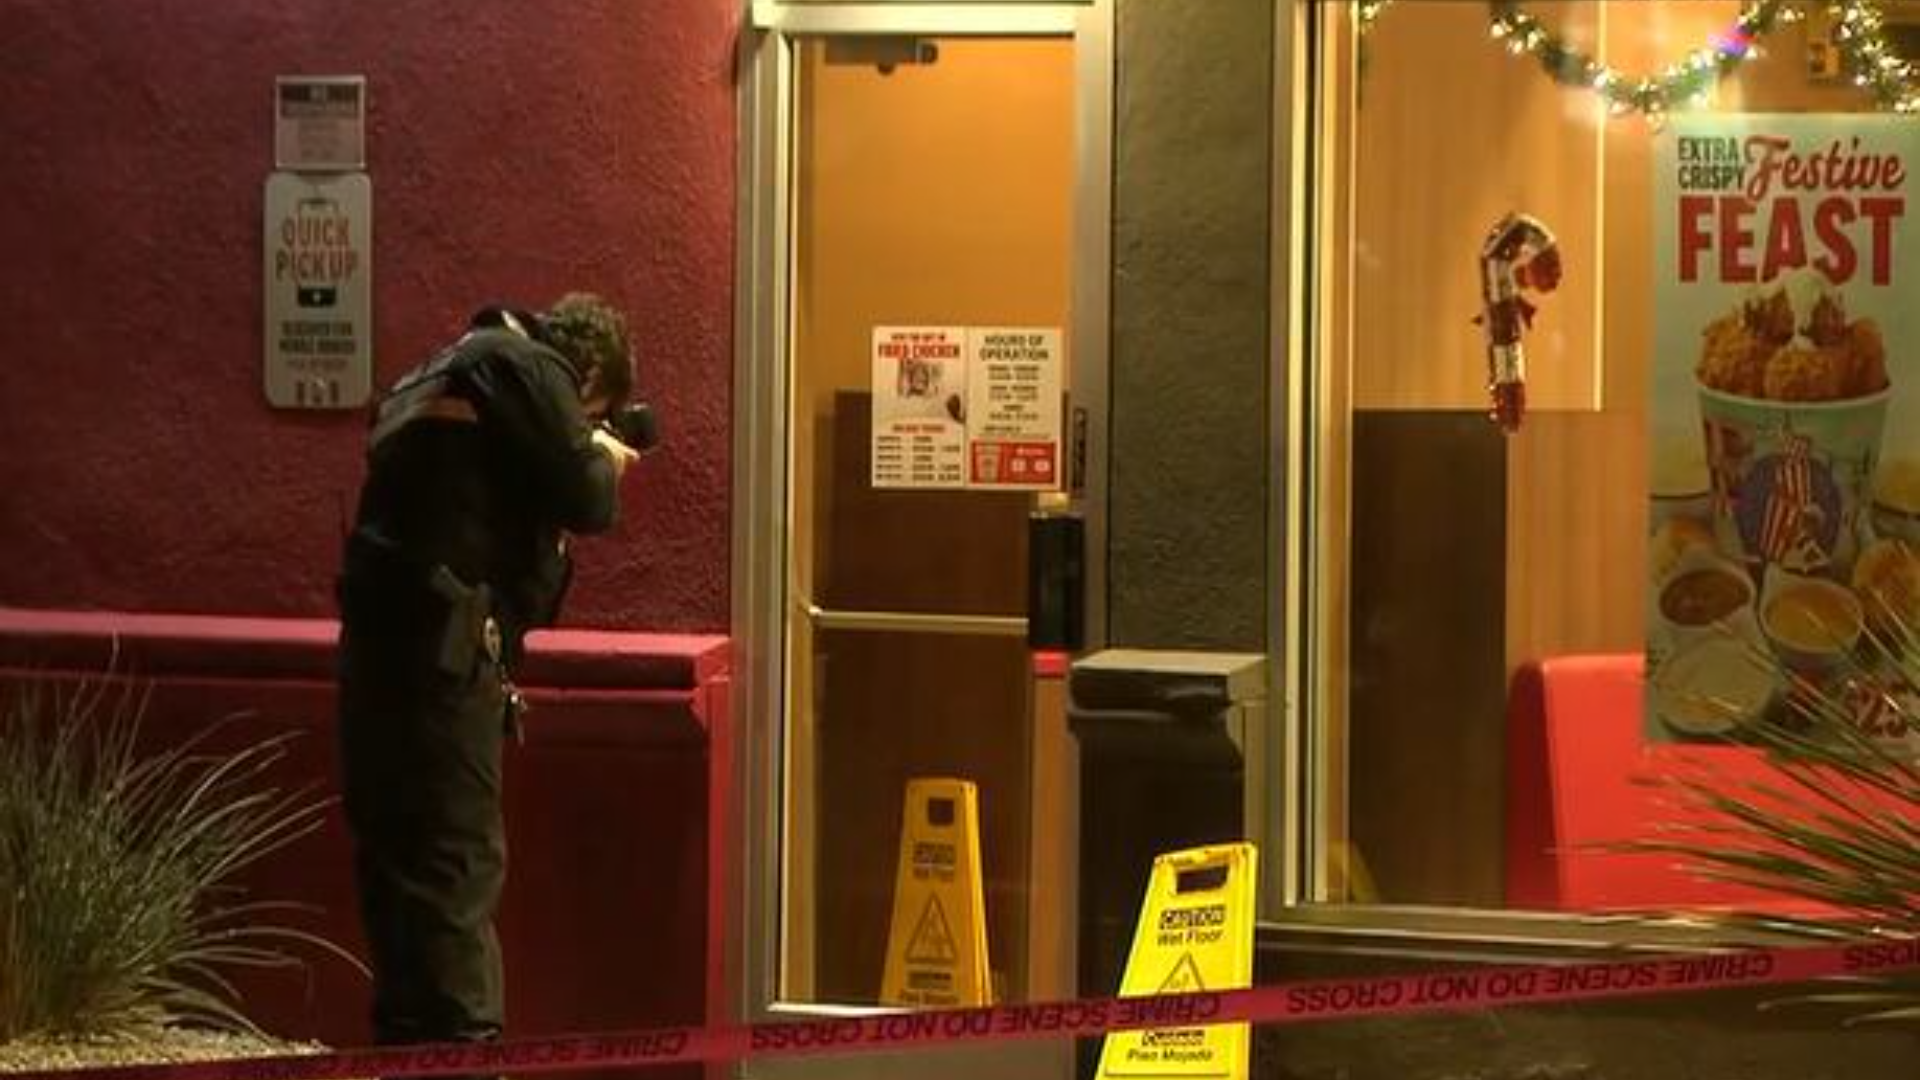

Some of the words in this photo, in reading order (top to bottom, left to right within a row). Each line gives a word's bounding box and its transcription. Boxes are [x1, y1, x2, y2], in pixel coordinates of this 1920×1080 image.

[1678, 137, 1739, 161] EXTRA
[1678, 166, 1745, 190] CRISPY
[1744, 135, 1906, 200] Festive
[281, 217, 350, 247] QUICK
[1679, 195, 1905, 286] FEAST
[979, 348, 1050, 361] OPERATION
[1028, 335, 1045, 347] OF
[1185, 930, 1224, 945] Floor
[1545, 962, 1656, 992] SCENE
[1667, 954, 1774, 984] CRIME
[1286, 982, 1400, 1014] CROSS
[1412, 976, 1479, 1004] NOT
[1487, 973, 1537, 998] DO
[868, 1016, 936, 1043] NOT
[948, 1014, 992, 1038] DO
[1001, 1004, 1112, 1034] SCENE
[585, 1032, 689, 1057] CRIME
[751, 1023, 862, 1050] CROSS
